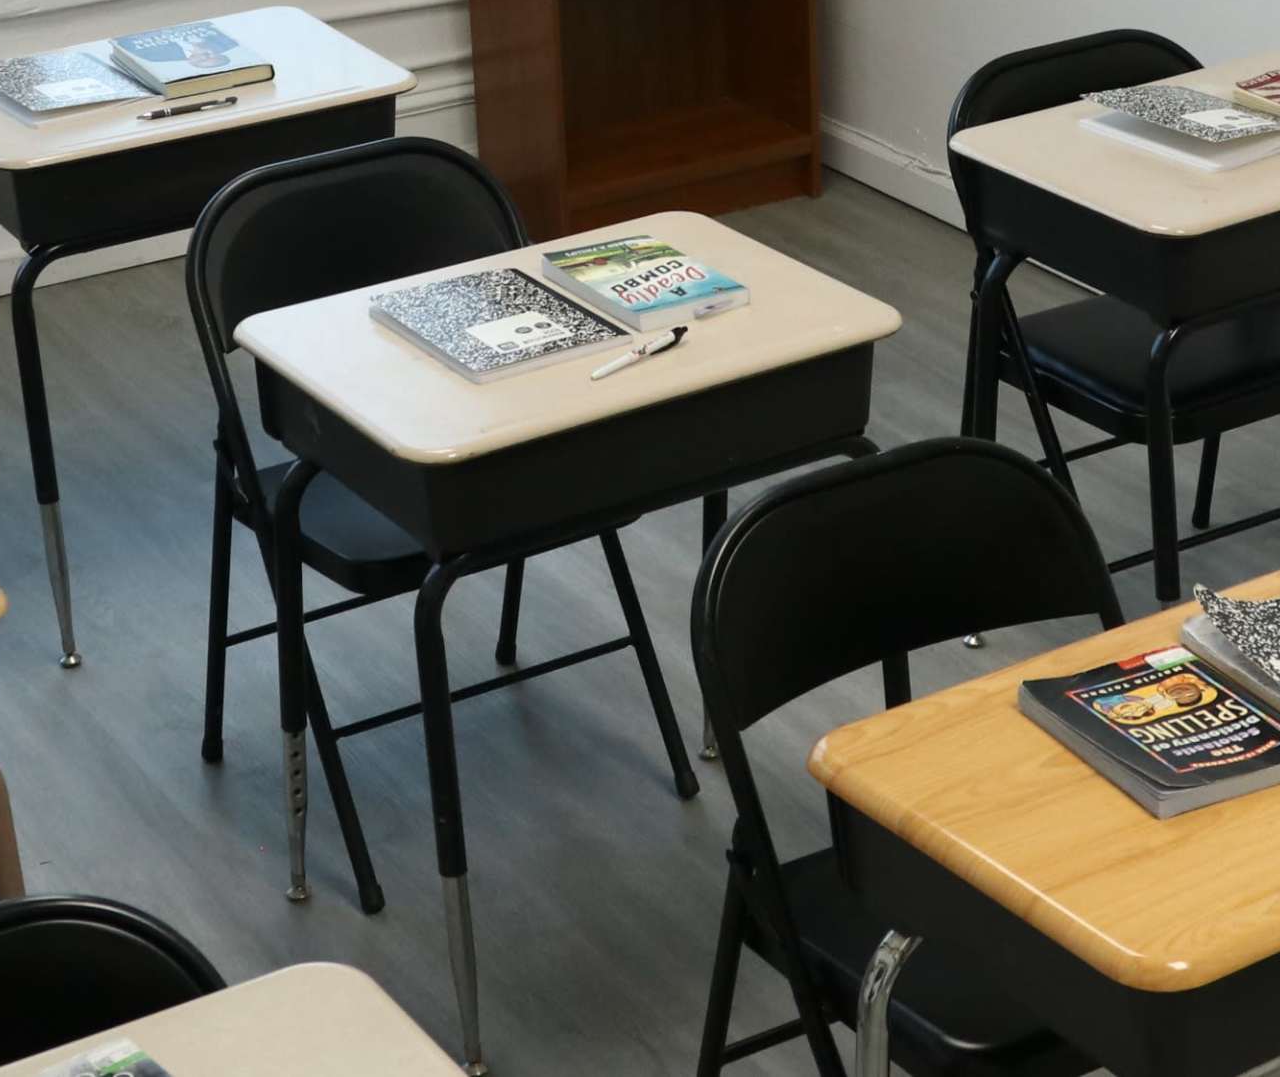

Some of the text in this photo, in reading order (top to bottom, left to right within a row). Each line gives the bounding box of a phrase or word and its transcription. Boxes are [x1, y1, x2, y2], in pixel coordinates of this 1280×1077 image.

[612, 259, 685, 295] COMBO
[619, 265, 708, 304] Deadly
[1127, 696, 1251, 747] SPELLING
